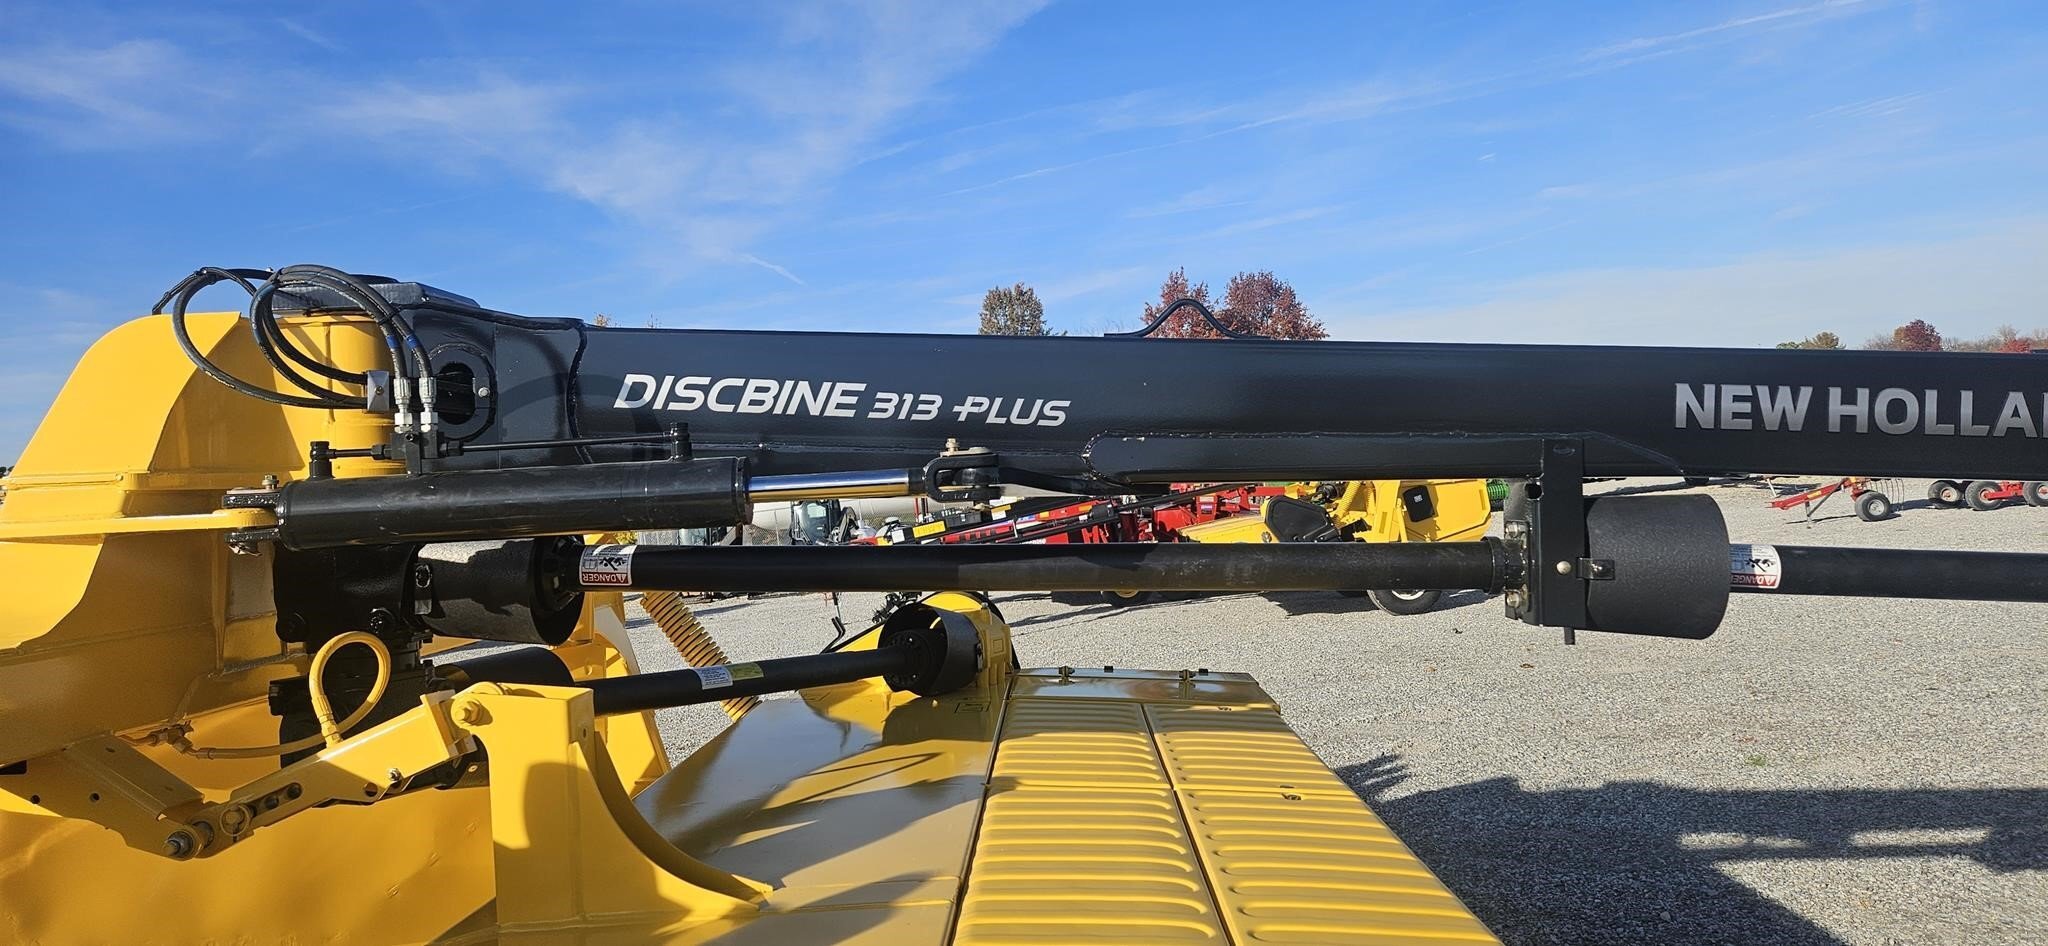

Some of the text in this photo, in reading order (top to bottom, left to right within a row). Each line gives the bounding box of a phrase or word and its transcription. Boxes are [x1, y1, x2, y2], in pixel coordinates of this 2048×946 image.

[613, 373, 1071, 427] DISCBINE 313 PLUS
[1675, 383, 2048, 439] NEW HOLLA
[582, 572, 617, 582] DANGER
[1730, 574, 1765, 585] DANGE
